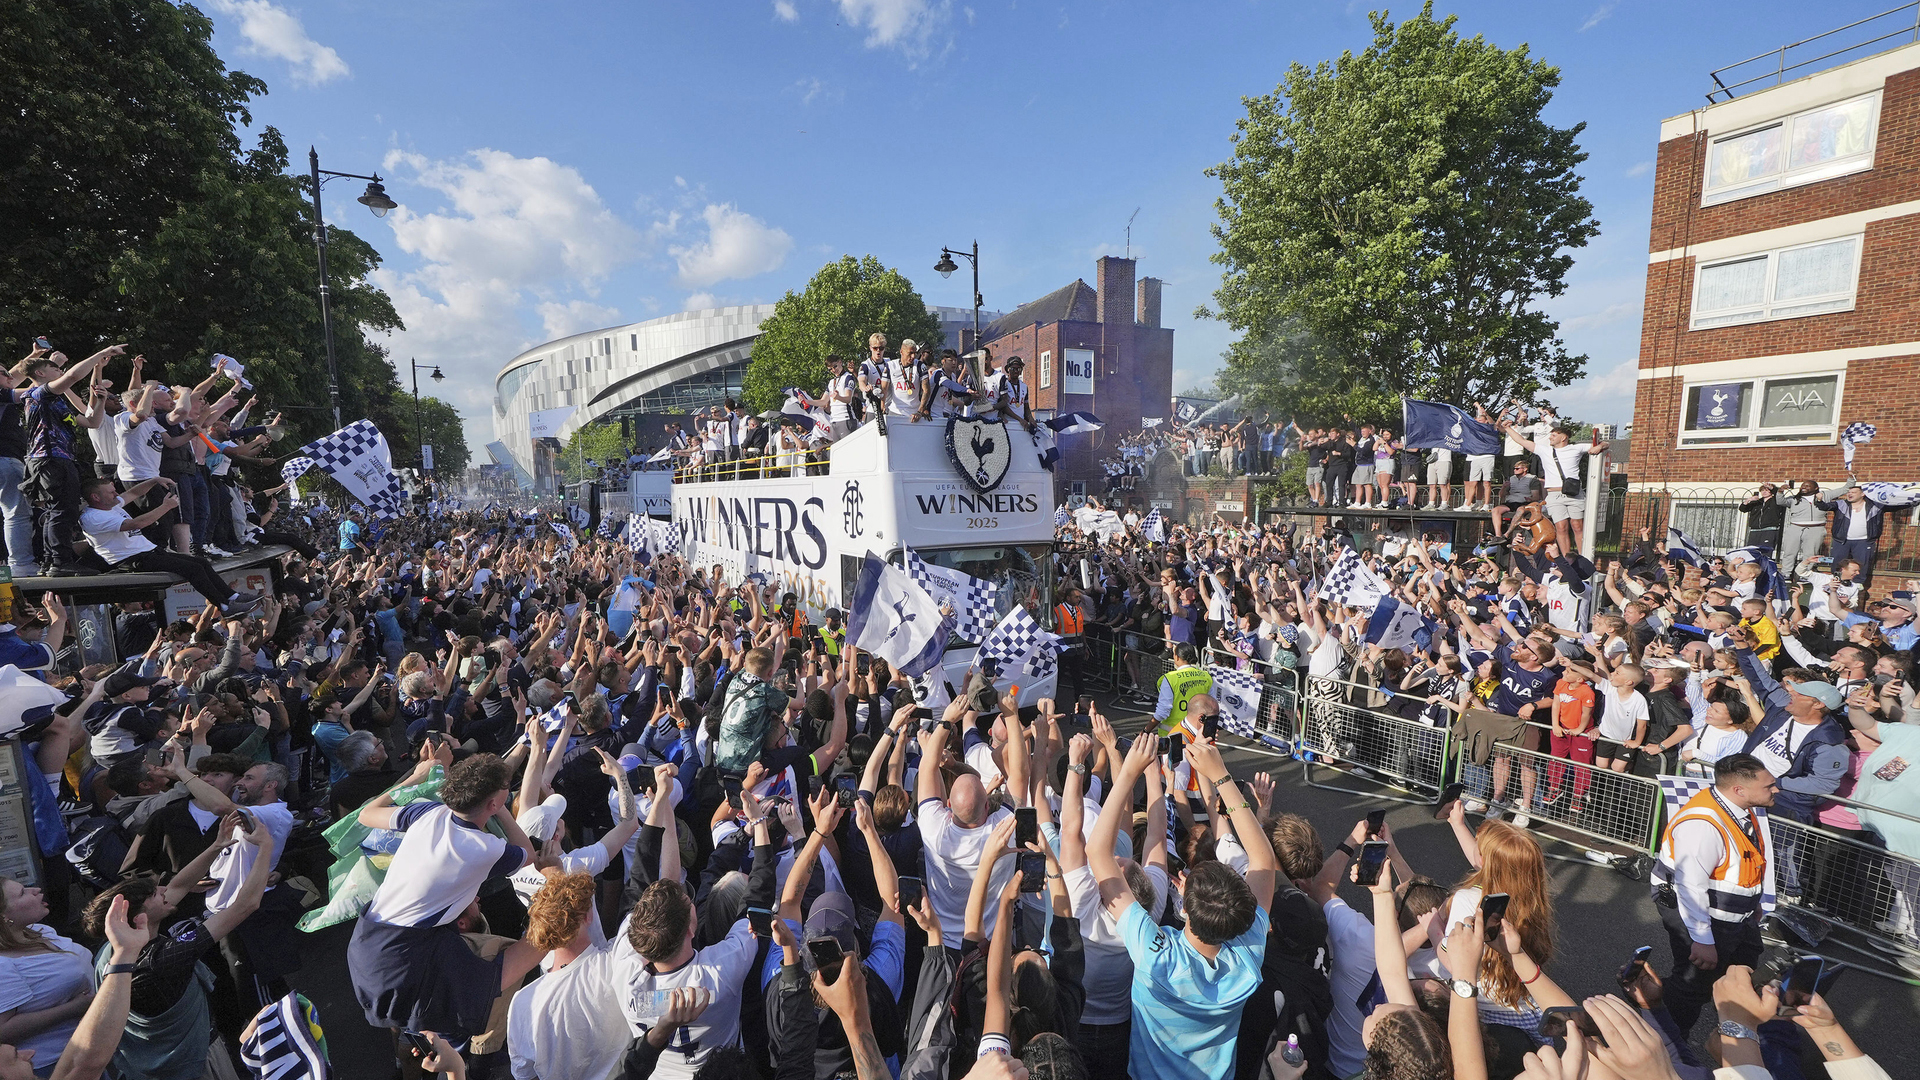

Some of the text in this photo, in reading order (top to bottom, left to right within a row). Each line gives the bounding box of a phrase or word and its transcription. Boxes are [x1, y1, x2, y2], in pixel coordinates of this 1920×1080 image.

[1776, 389, 1825, 407] AIA
[815, 420, 831, 433] AIA
[915, 493, 1038, 515] WINNERS
[966, 517, 998, 529] 2025
[688, 495, 827, 570] WINNERS
[930, 572, 959, 588] EUROPEAN
[784, 569, 827, 611] 2025
[1177, 671, 1206, 679] STEWARD
[1502, 676, 1533, 698] AIA
